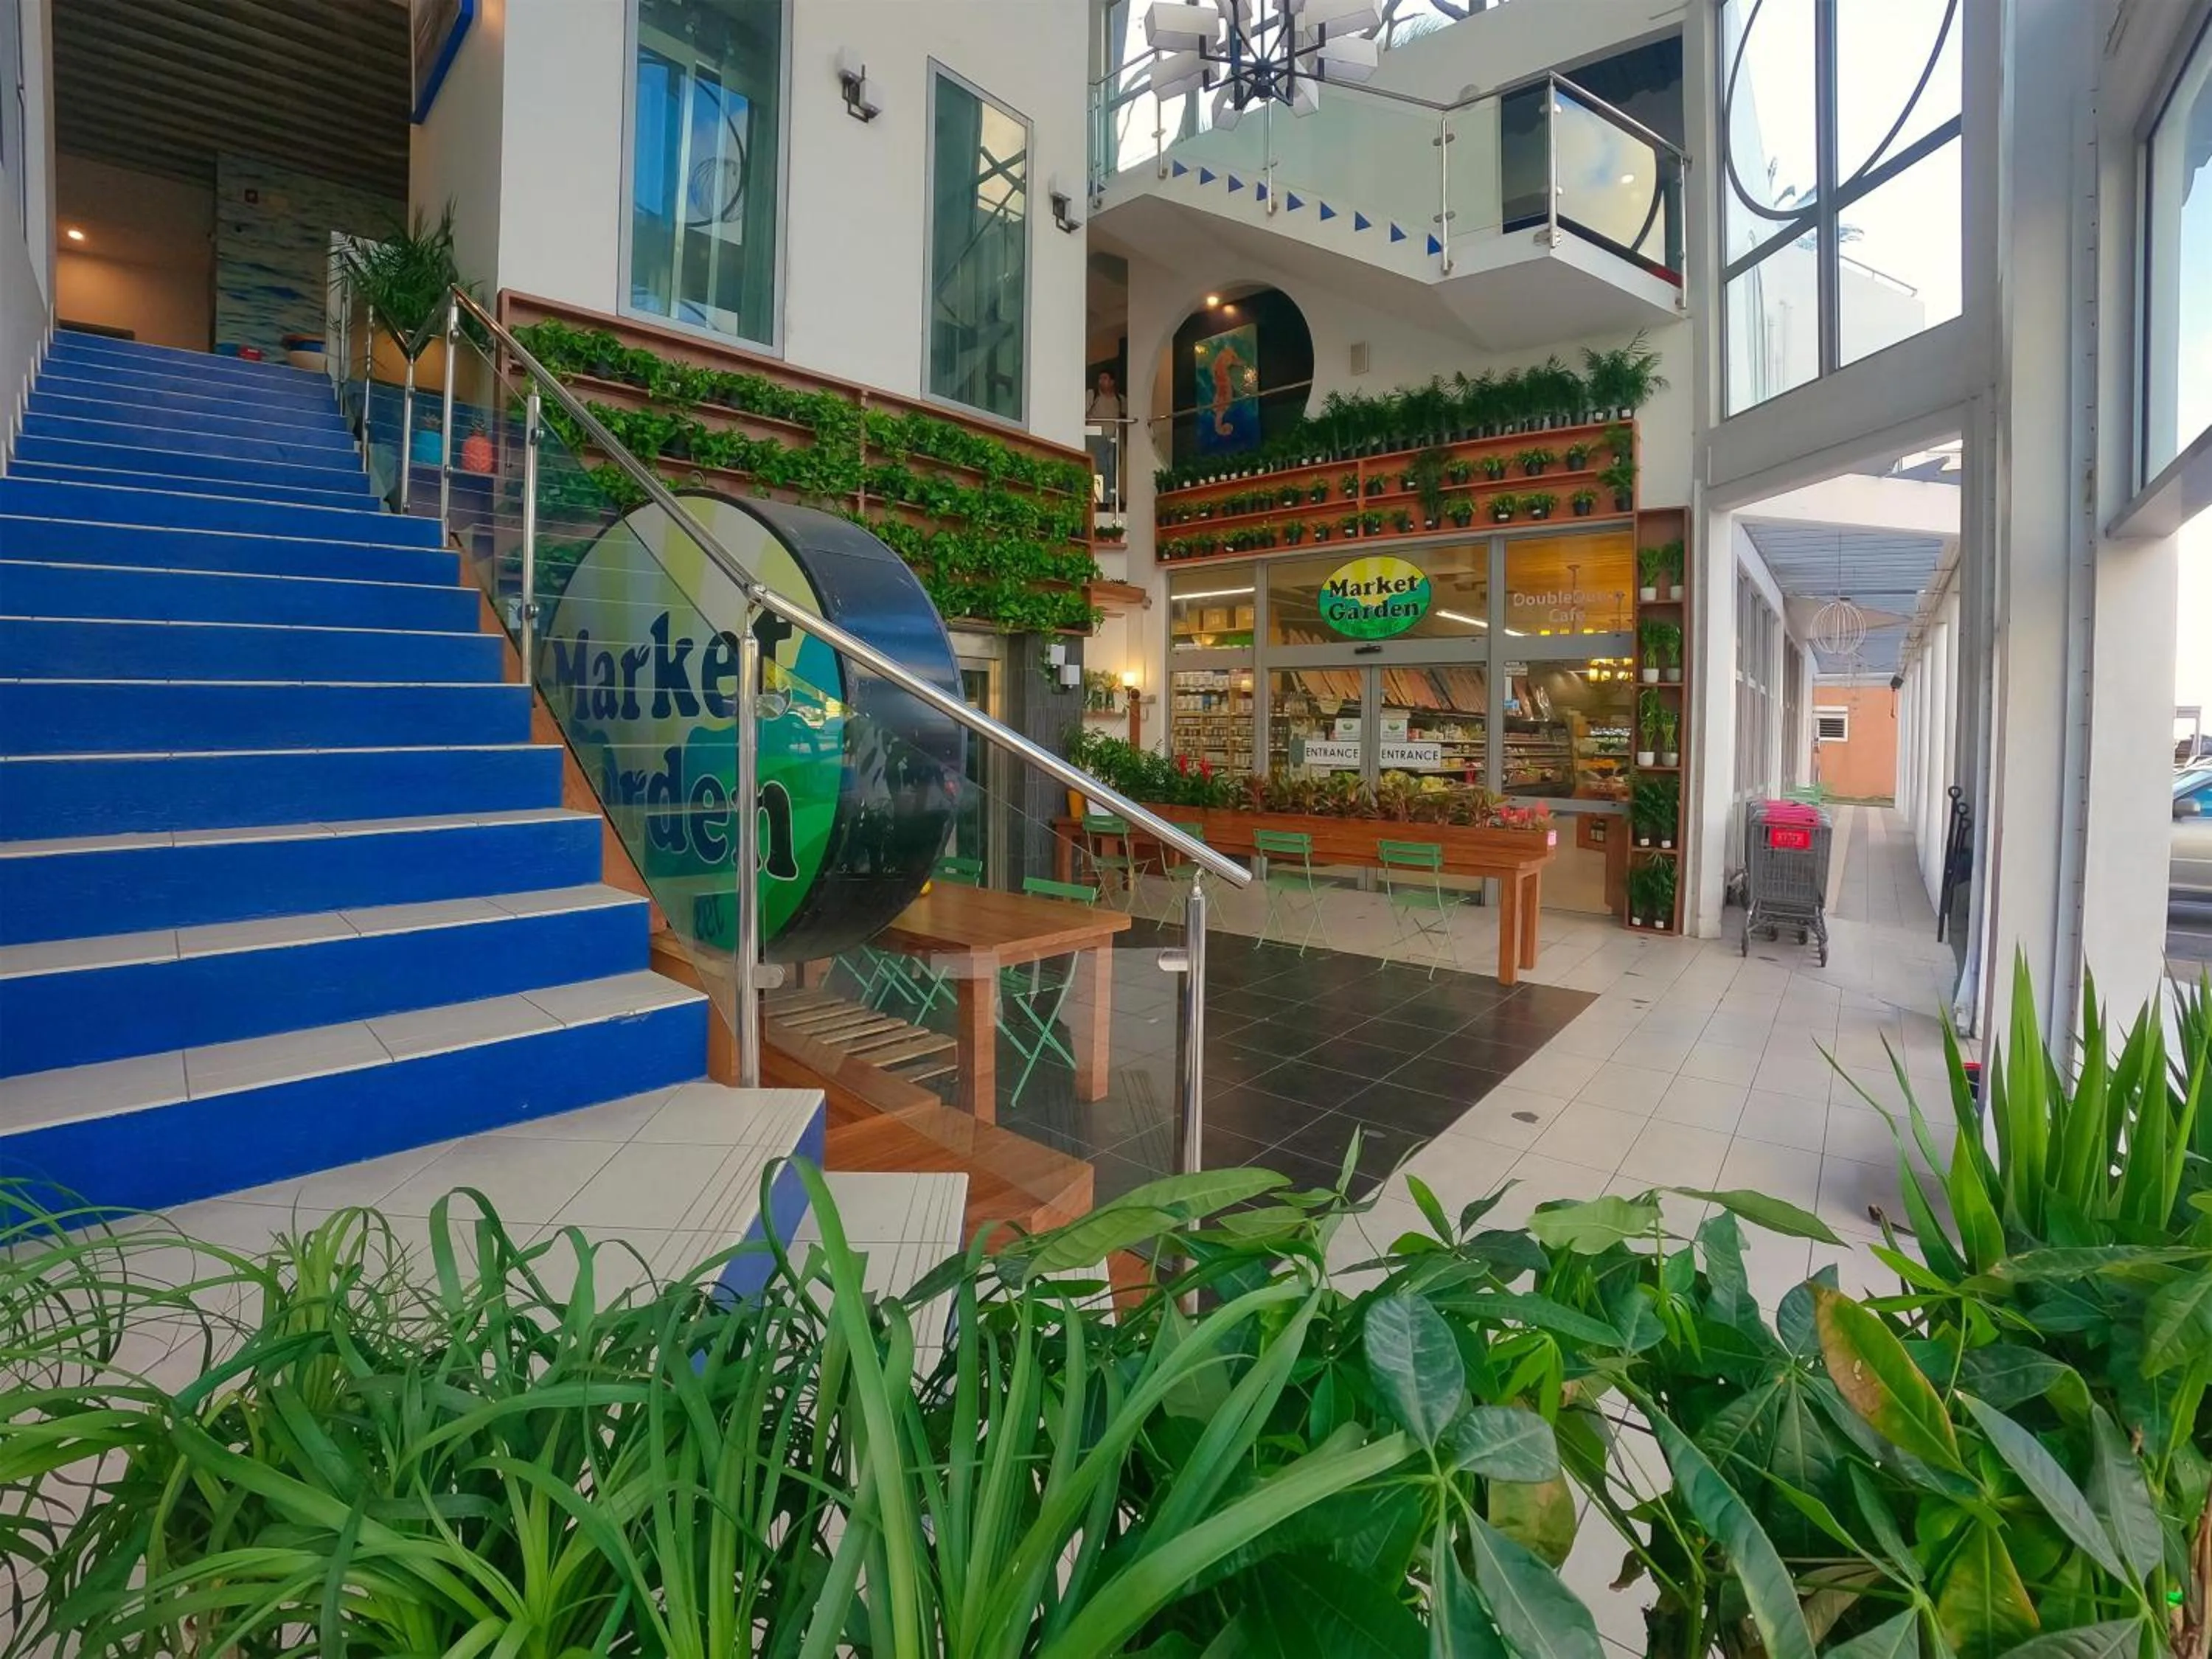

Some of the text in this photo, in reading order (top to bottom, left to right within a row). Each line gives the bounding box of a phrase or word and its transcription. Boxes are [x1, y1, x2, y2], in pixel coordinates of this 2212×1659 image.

[1329, 574, 1419, 598] Market
[1329, 599, 1419, 621] Garden
[1306, 747, 1359, 759] ENTRANCE
[1381, 749, 1439, 761] ENTRANCE
